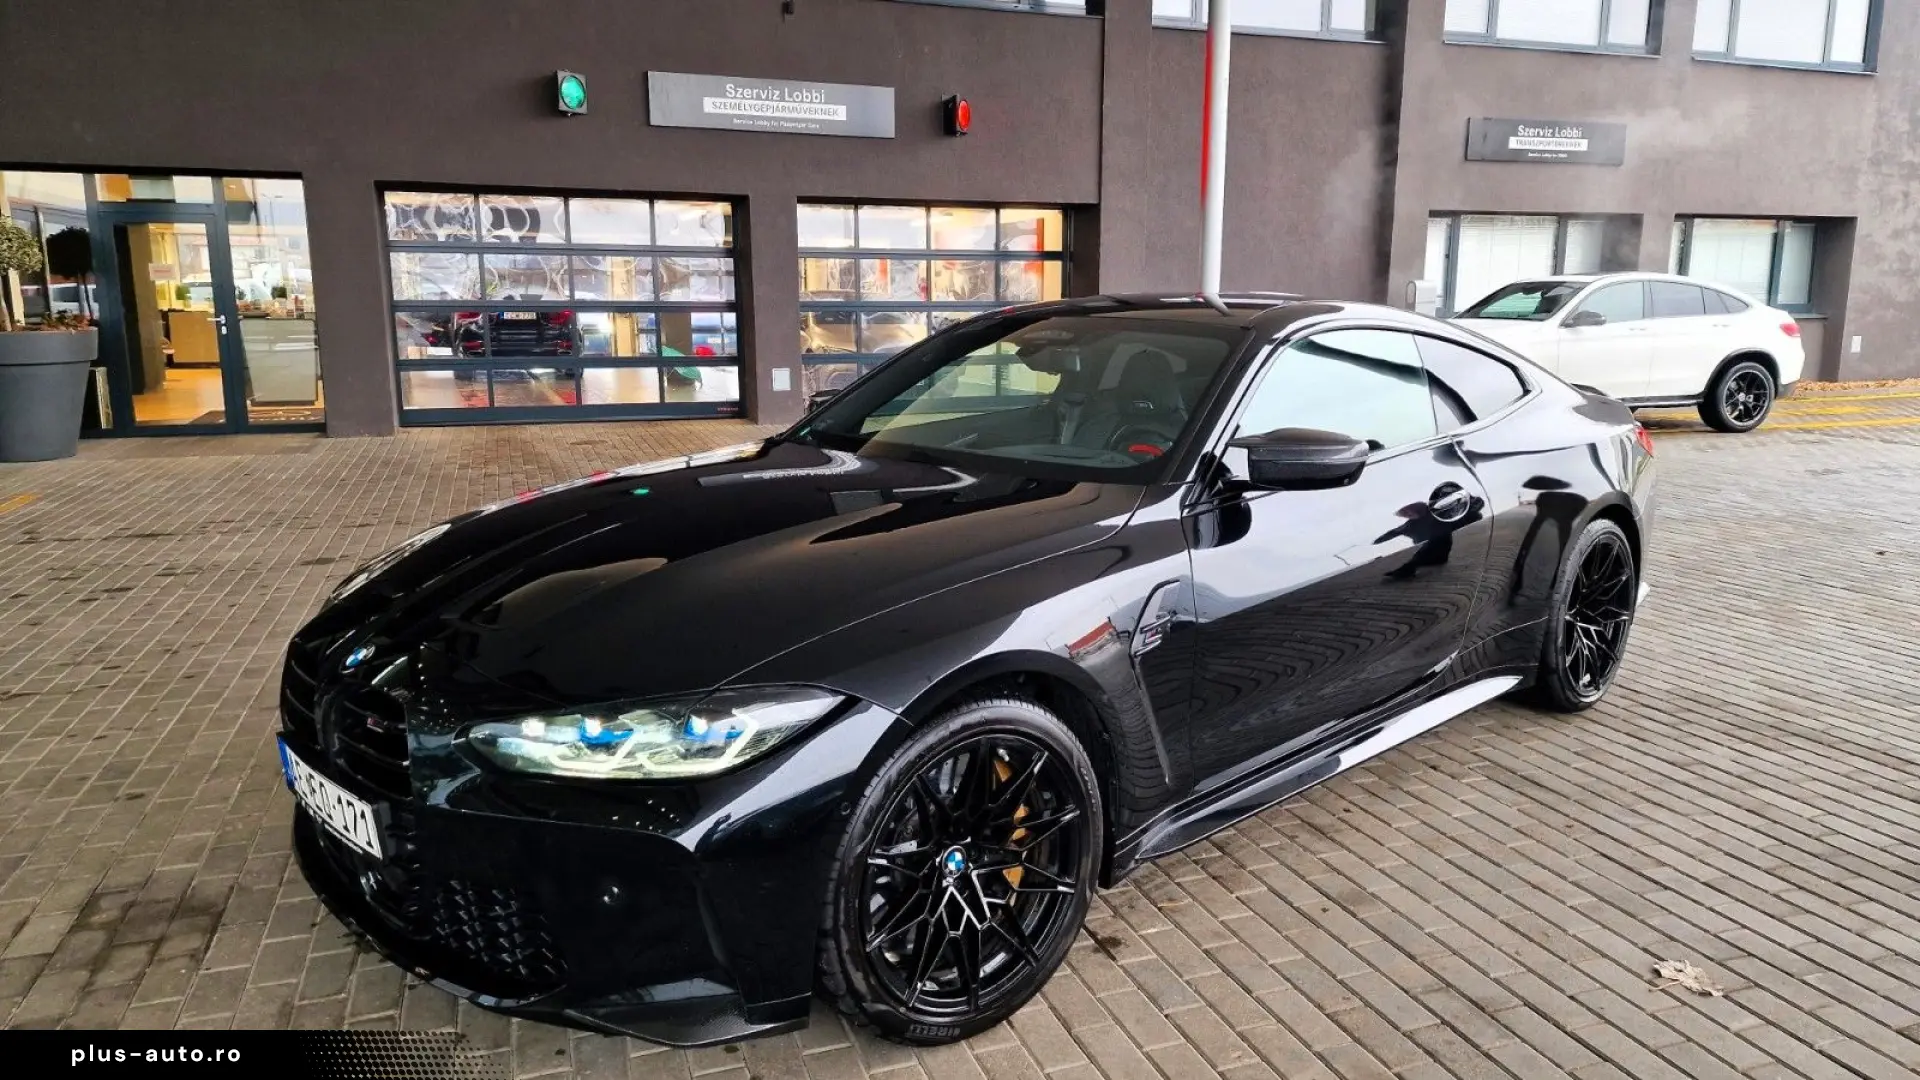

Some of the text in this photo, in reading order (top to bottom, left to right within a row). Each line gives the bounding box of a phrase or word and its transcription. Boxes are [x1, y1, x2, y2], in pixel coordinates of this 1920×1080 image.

[725, 83, 825, 103] Szerviz Lobbi
[1517, 125, 1583, 138] Szerviz Lobbi
